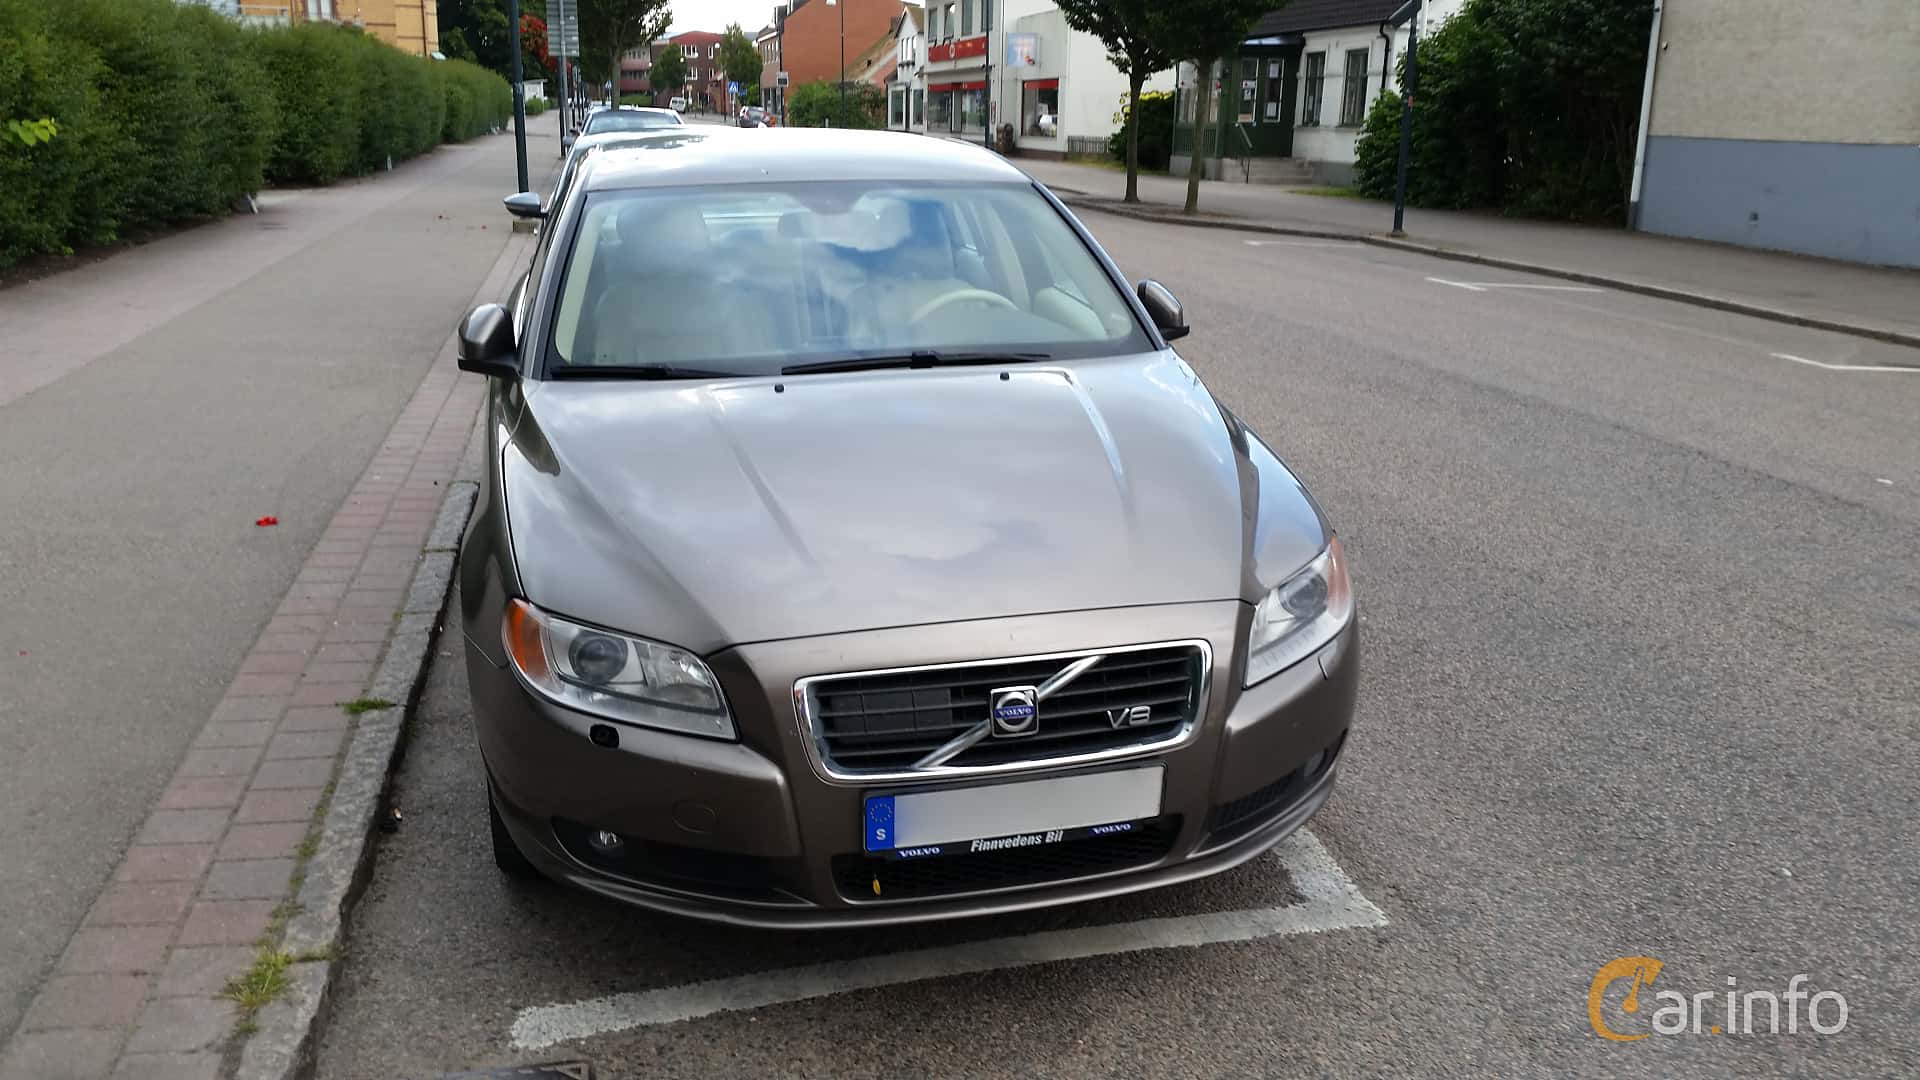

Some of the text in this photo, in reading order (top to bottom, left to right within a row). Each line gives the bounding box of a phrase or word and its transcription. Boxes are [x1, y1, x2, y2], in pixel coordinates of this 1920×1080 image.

[998, 706, 1032, 717] VOLVO
[1107, 705, 1150, 729] V8
[875, 828, 887, 841] S
[1093, 822, 1132, 835] VOLVO
[970, 829, 1064, 853] Finnvedens Bil
[899, 846, 941, 858] VOLVO
